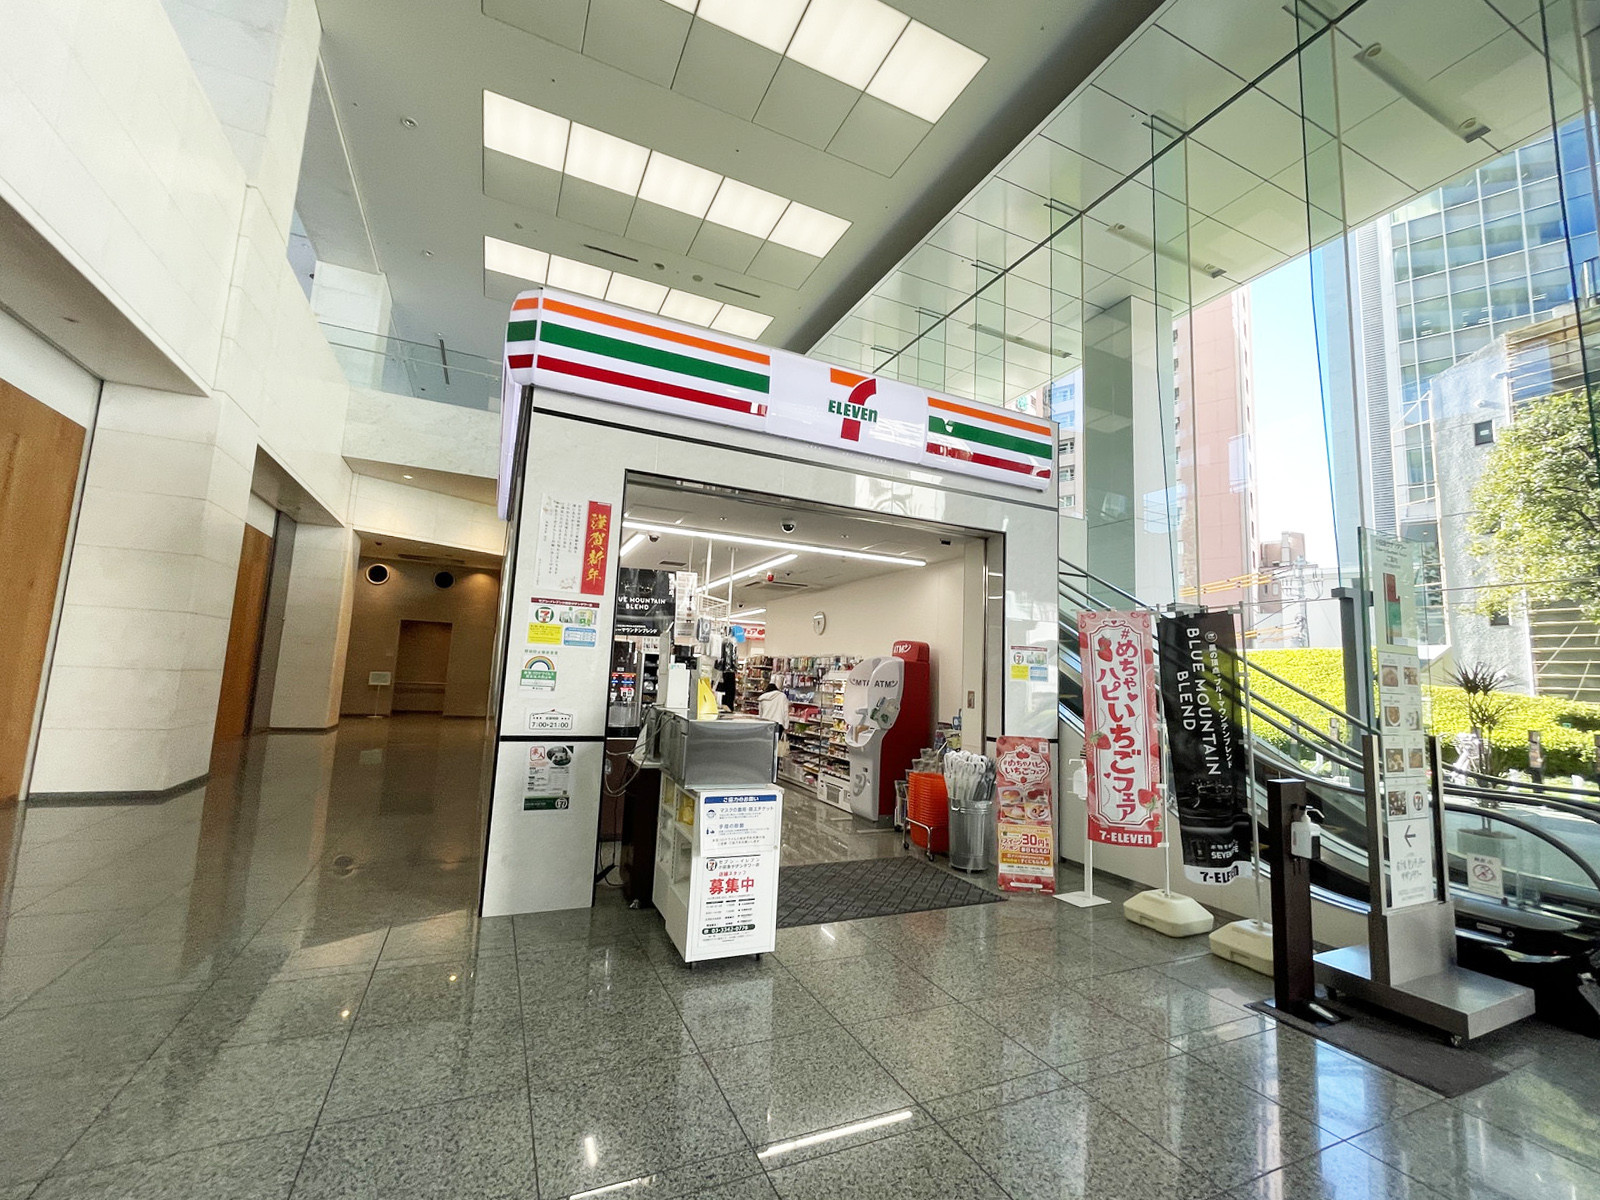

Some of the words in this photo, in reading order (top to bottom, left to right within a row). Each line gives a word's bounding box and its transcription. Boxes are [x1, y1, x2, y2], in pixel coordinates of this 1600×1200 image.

[830, 368, 876, 442] 7
[587, 513, 608, 585] 謹賀新年
[625, 603, 650, 611] BLEND
[629, 597, 666, 605] MOUNTAIN
[1186, 628, 1206, 673] BLUE
[874, 679, 892, 688] ATM
[1177, 671, 1197, 731] BLEND
[1194, 679, 1222, 775] MOUNTAIN
[709, 877, 755, 895] 募集中
